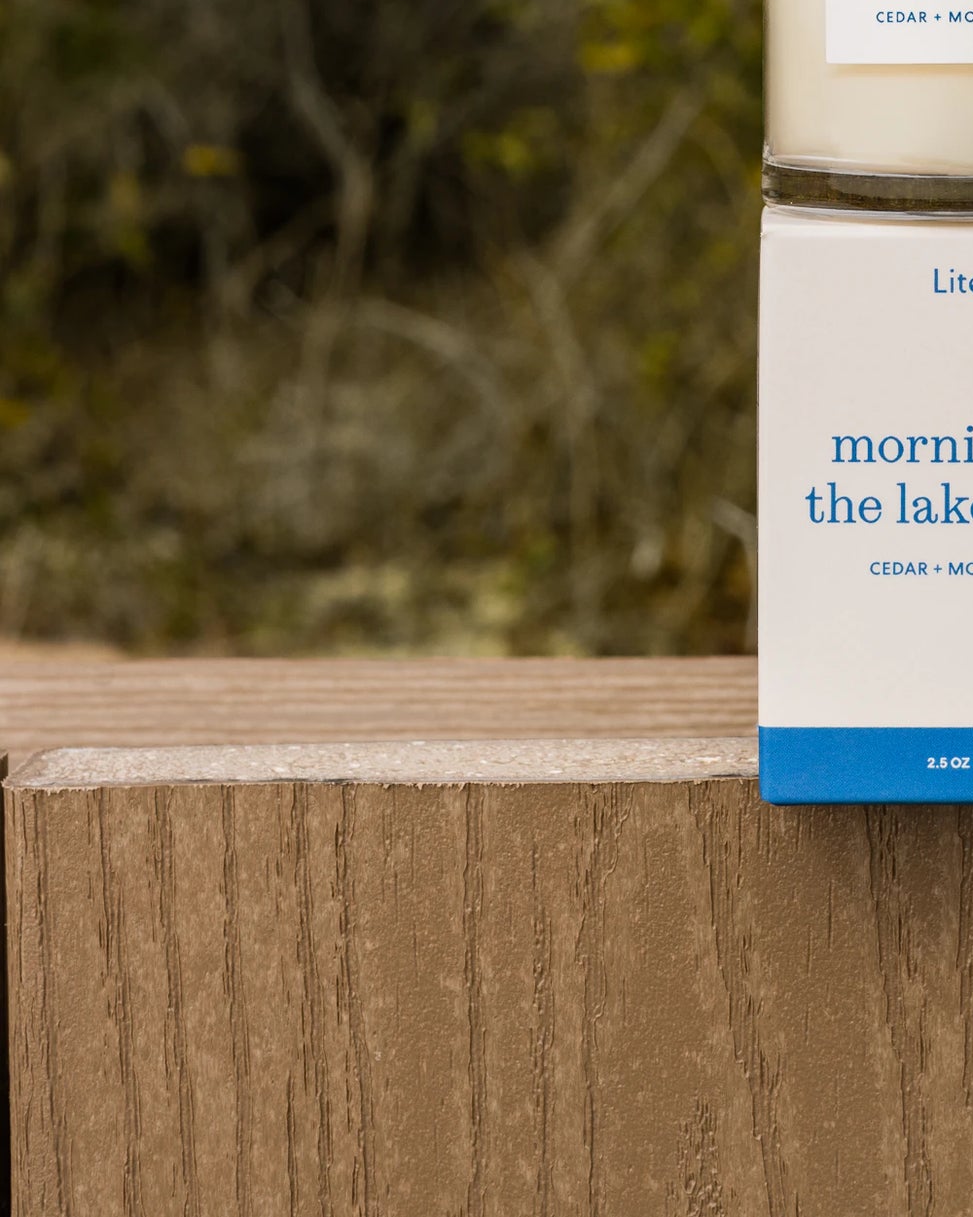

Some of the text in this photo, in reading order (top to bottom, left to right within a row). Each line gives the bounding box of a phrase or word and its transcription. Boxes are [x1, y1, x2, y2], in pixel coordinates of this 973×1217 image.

[875, 10, 927, 24] CEDAR
[804, 481, 883, 524] the
[869, 561, 928, 576] CEDAR
[926, 756, 948, 769] 2.5
[949, 756, 971, 770] OZ
